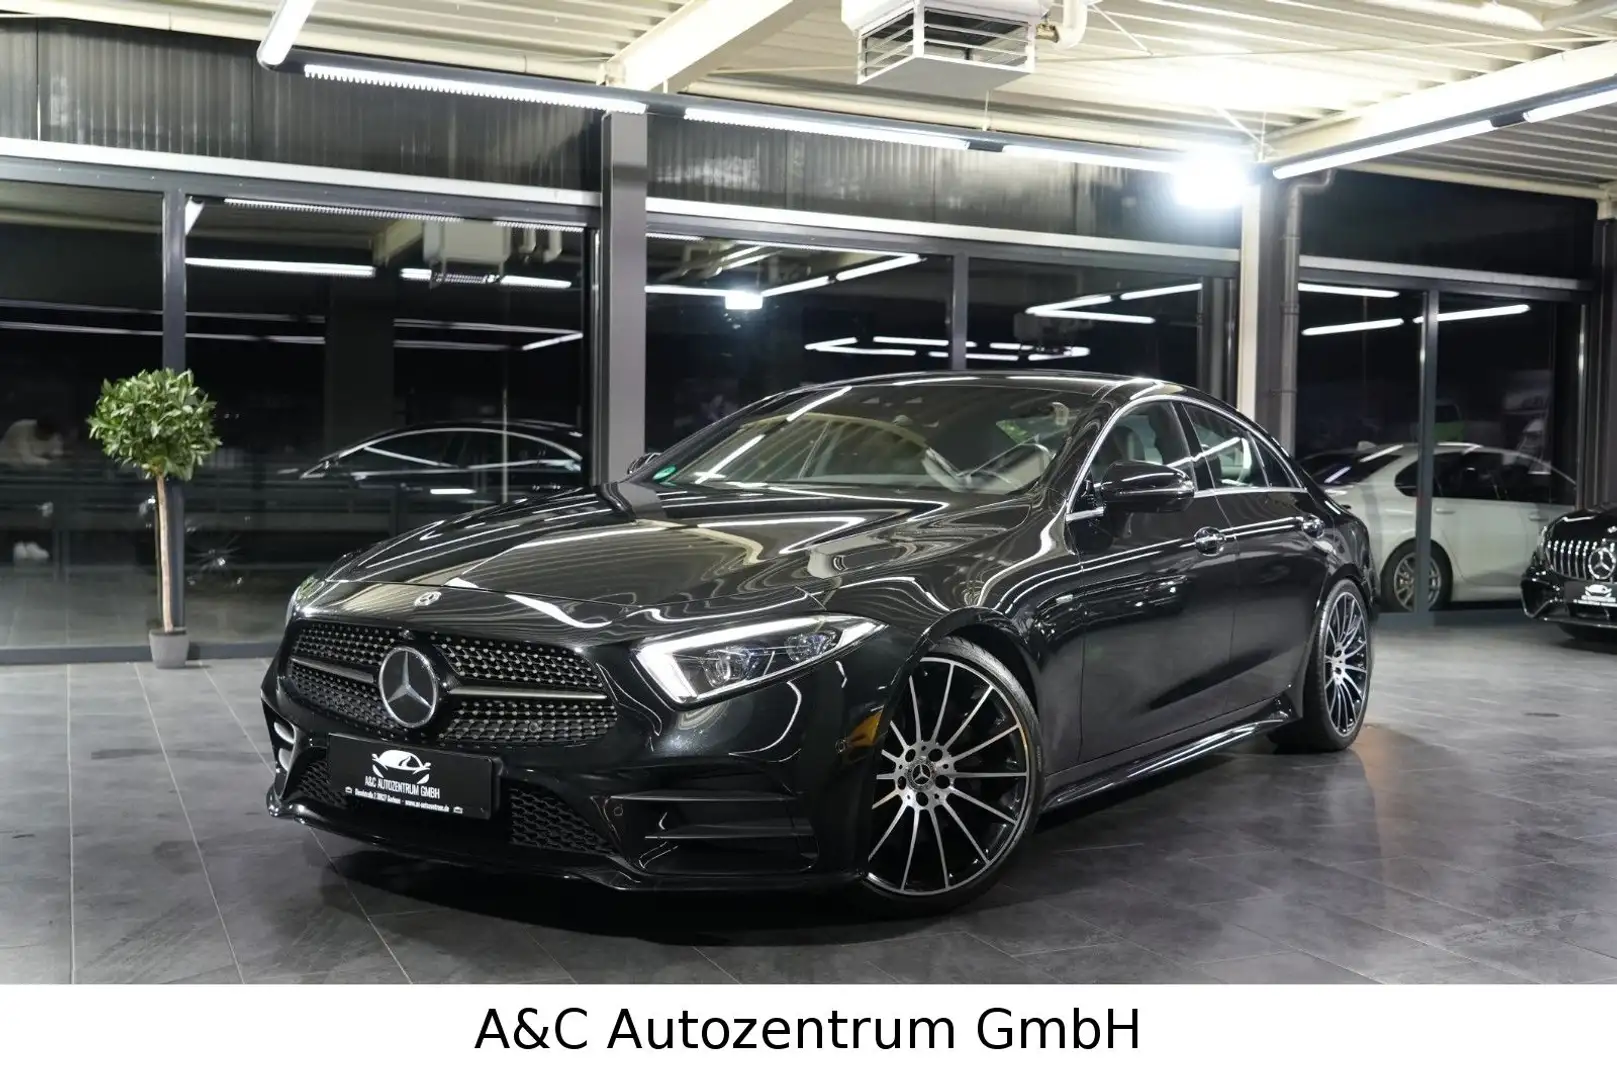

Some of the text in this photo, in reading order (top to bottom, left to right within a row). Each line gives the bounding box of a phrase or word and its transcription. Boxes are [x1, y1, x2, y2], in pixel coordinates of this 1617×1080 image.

[364, 775, 377, 788] A&C
[377, 778, 419, 796] AUTOZENTRUM
[420, 786, 440, 799] GMBH
